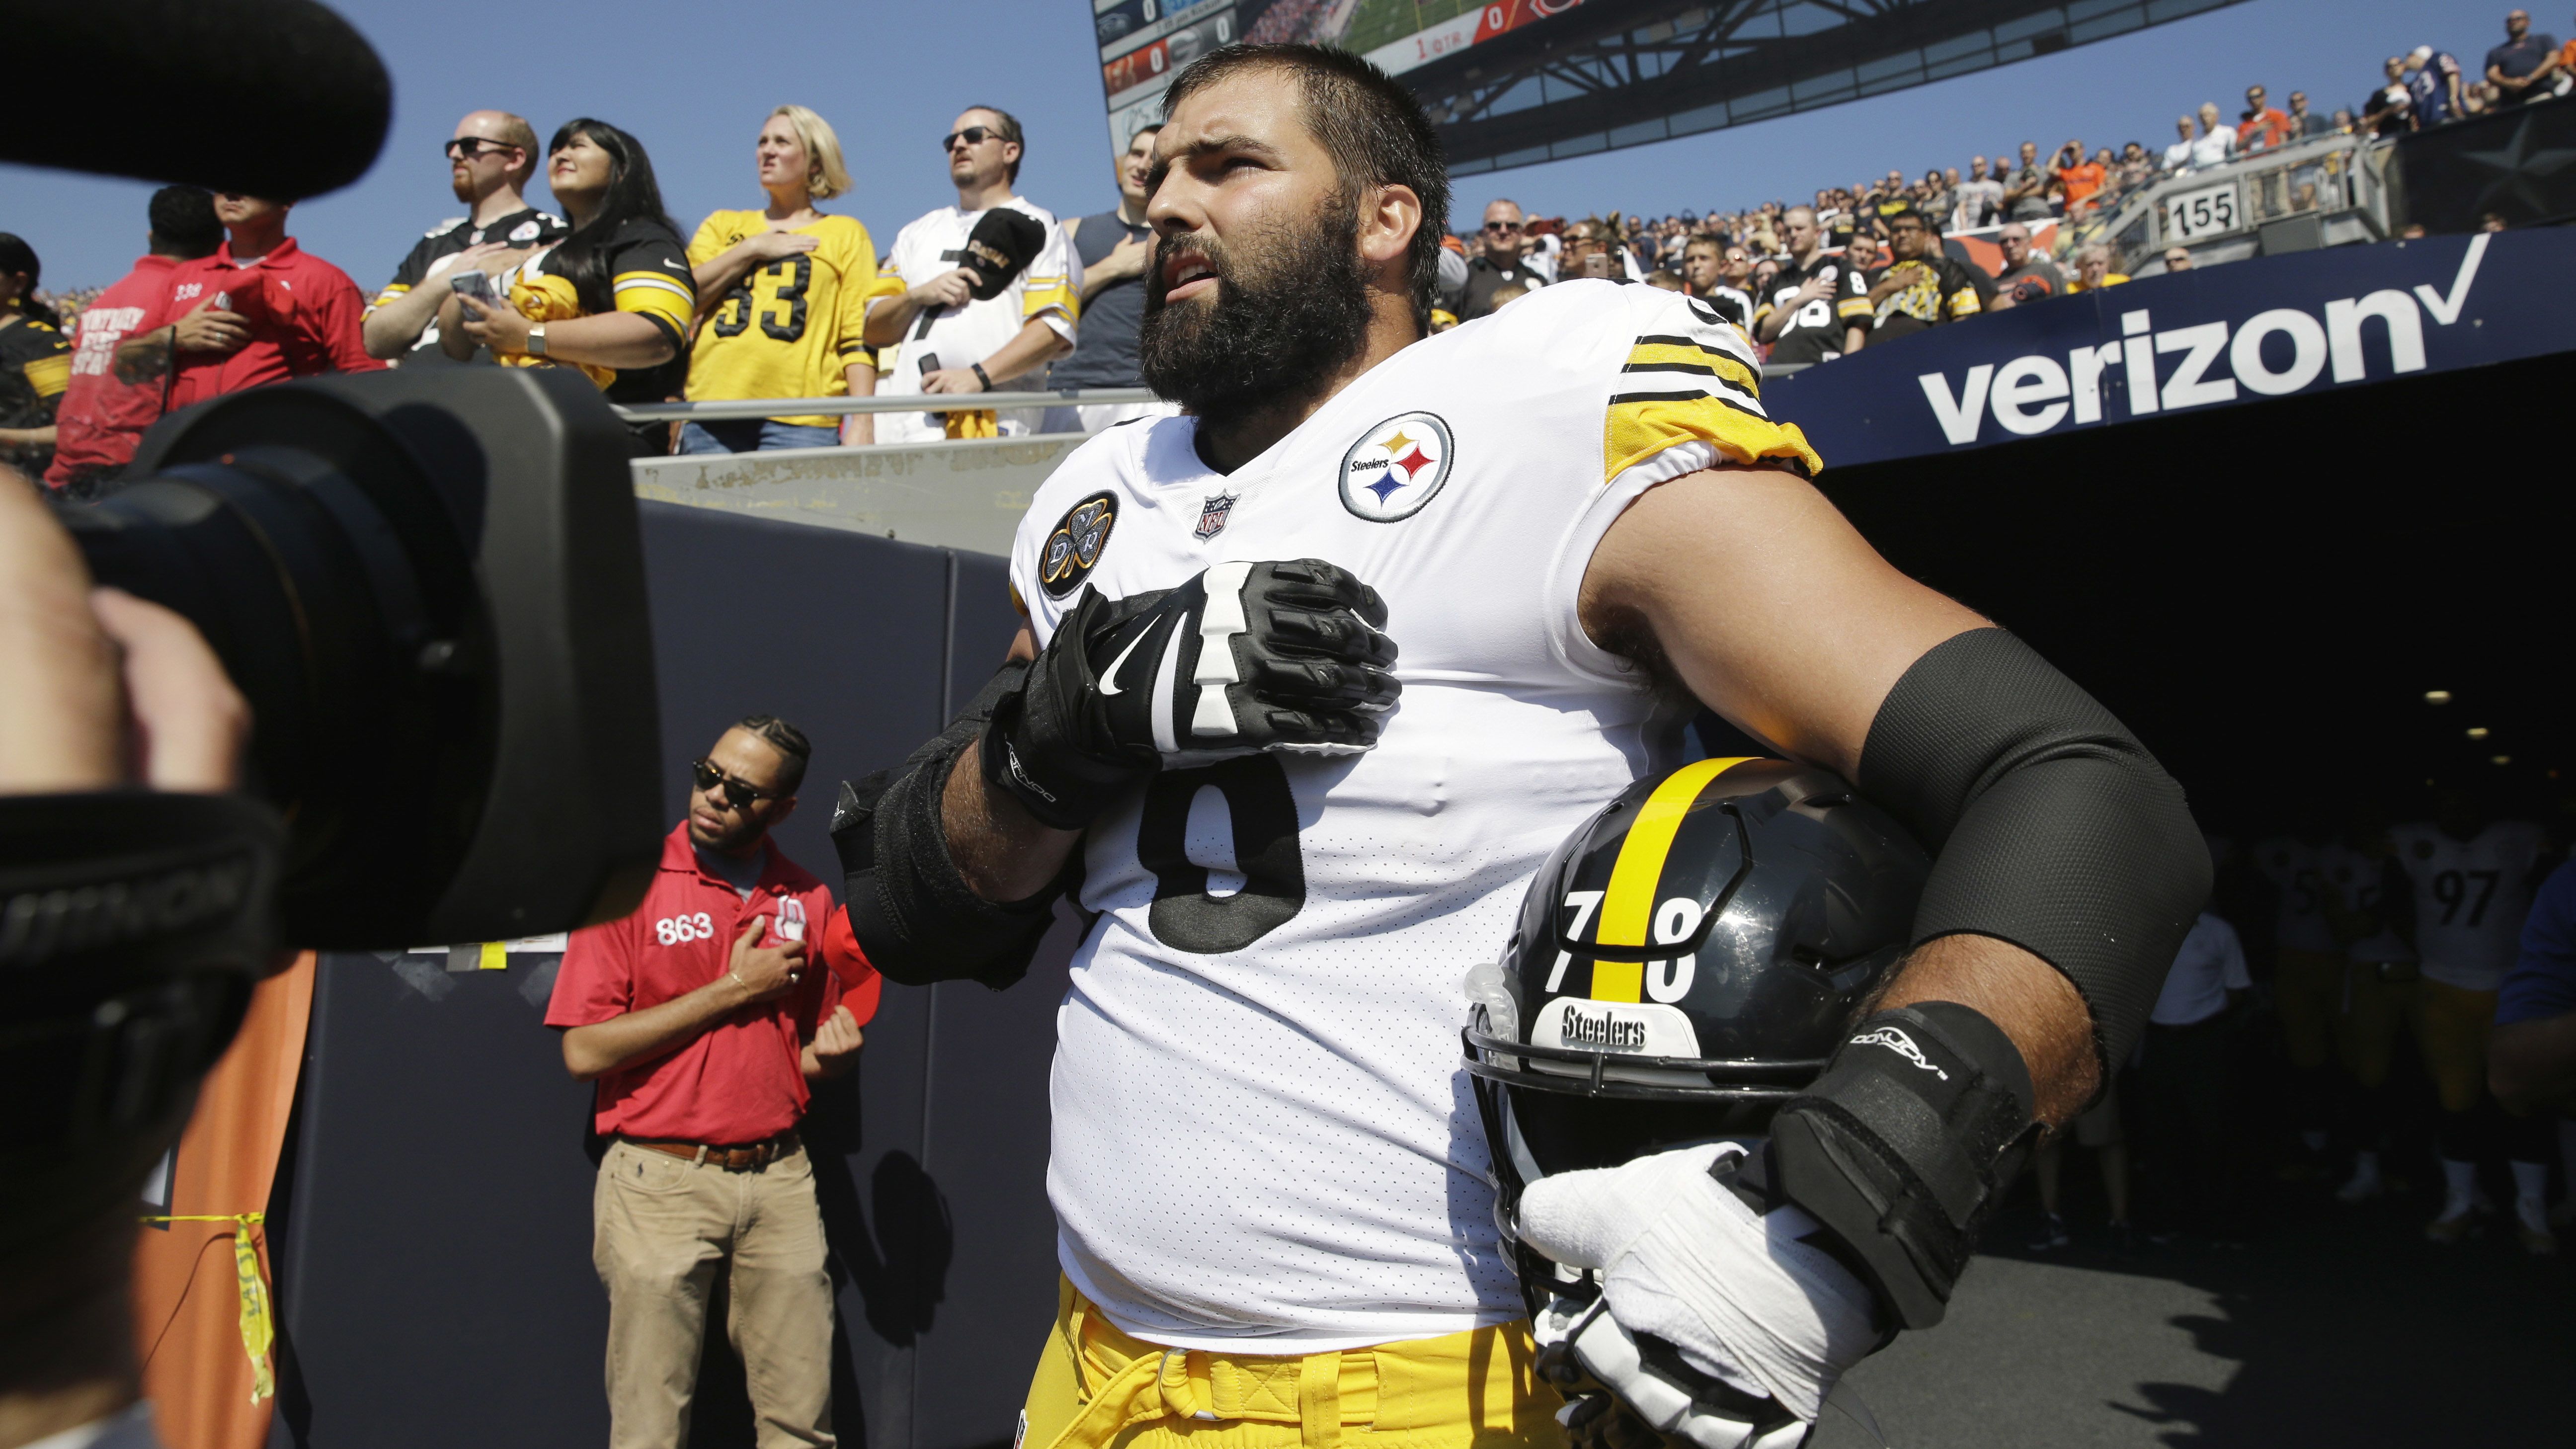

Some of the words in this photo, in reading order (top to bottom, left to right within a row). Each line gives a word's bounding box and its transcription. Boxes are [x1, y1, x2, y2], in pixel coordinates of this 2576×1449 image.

[1216, 16, 1230, 44] 0
[1488, 6, 1504, 30] 0
[1432, 31, 1463, 54] QTR
[1149, 47, 1164, 74] 0
[2174, 193, 2232, 236] 155
[1918, 288, 2427, 445] verizon
[1351, 458, 1389, 472] Steelers
[1075, 510, 1095, 531] M
[1198, 511, 1225, 533] NFL
[1049, 542, 1067, 564] D
[2433, 869, 2500, 926] 97
[655, 911, 714, 946] 863
[1562, 1004, 1647, 1047] Steelers
